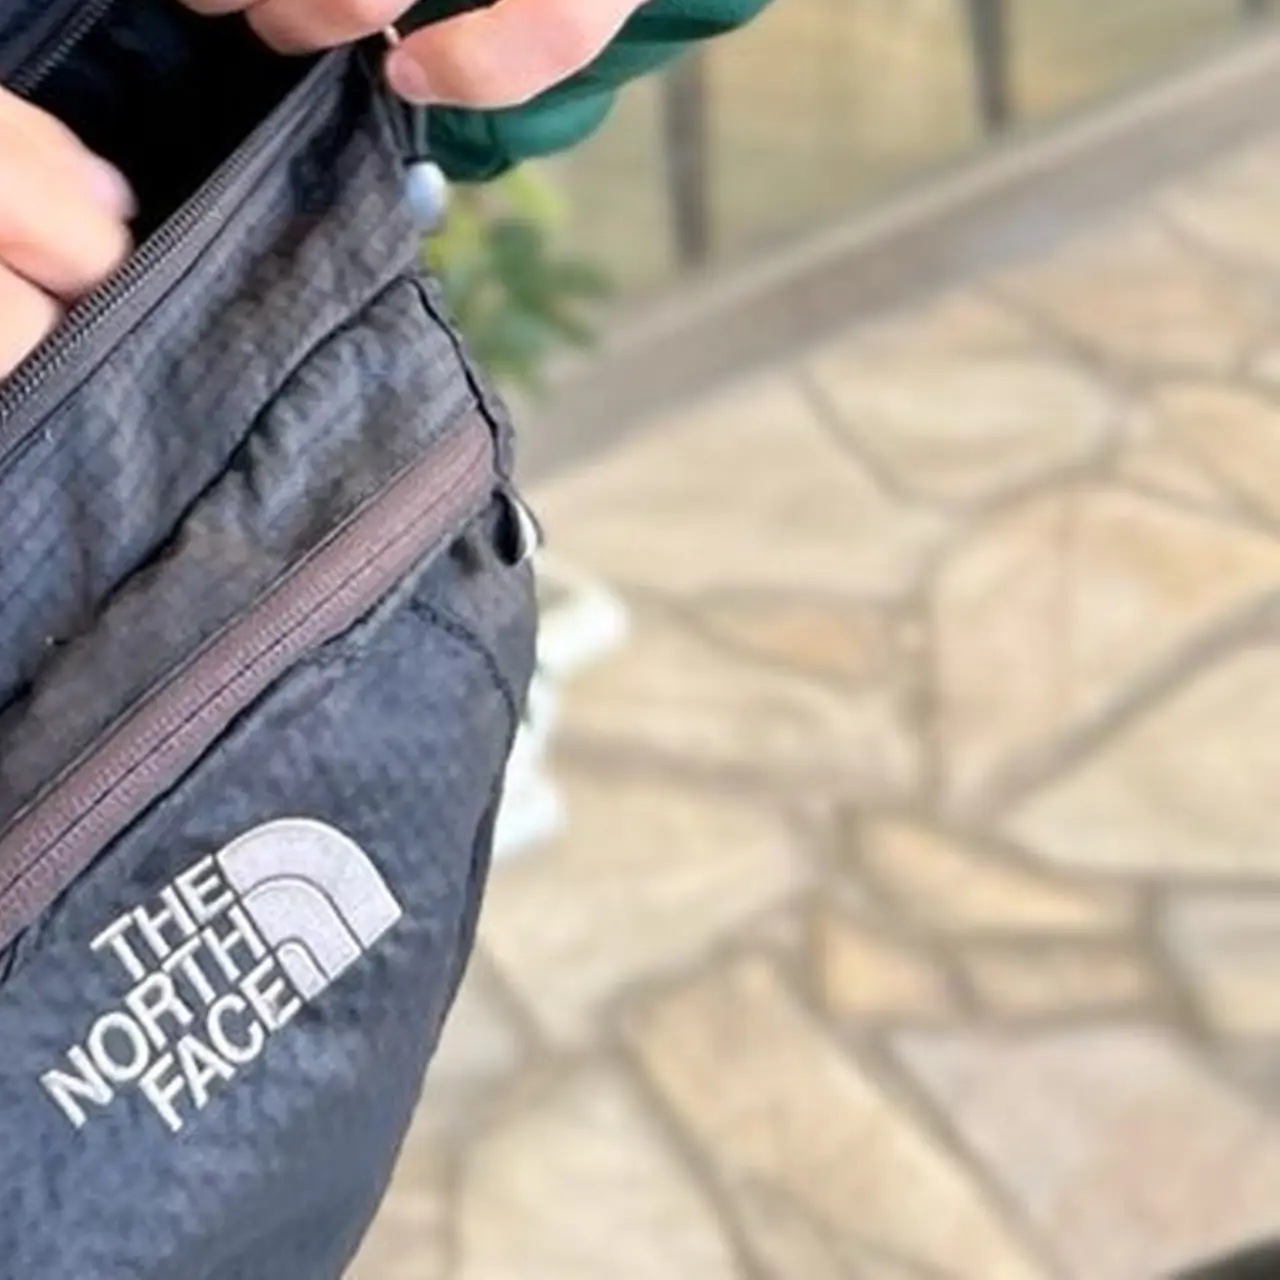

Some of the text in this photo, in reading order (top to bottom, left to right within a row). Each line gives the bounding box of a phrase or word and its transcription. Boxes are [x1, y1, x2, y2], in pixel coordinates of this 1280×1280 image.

[90, 853, 235, 982] THE
[40, 903, 268, 1130] NORTH
[138, 955, 301, 1133] FACE
